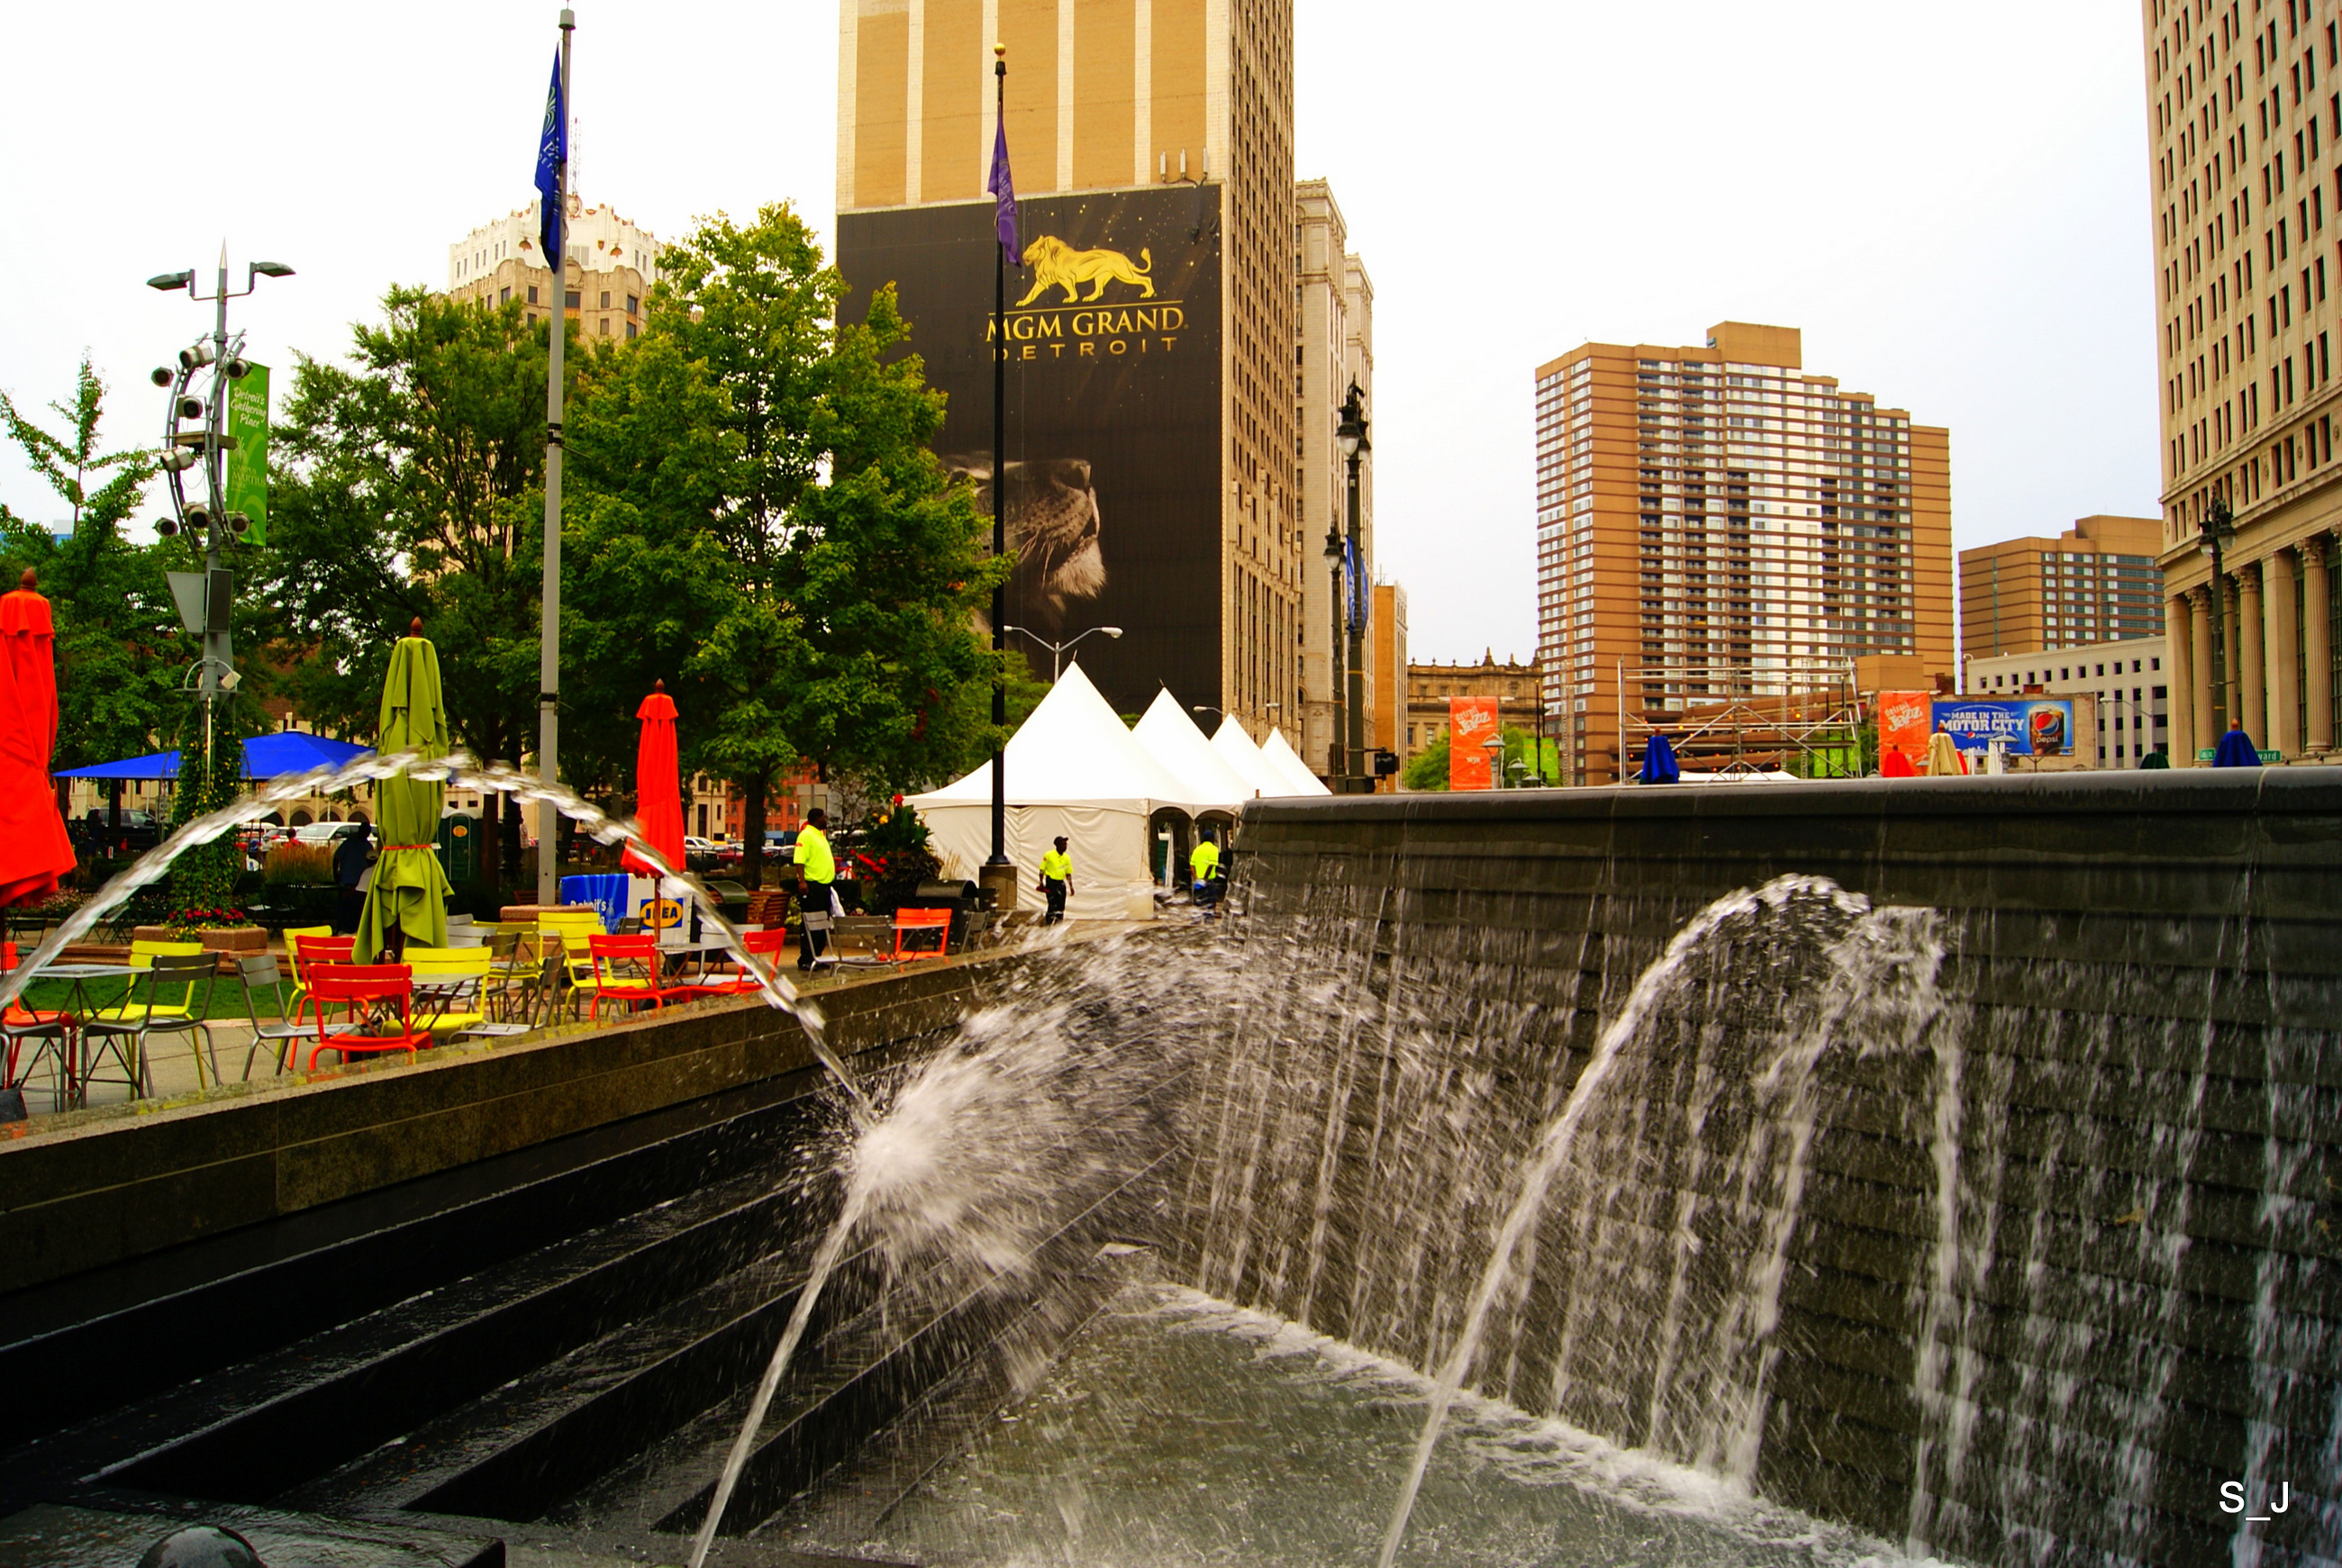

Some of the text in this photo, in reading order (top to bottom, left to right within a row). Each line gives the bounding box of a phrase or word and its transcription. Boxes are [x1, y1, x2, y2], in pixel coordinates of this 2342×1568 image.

[985, 307, 1185, 342] MGM GRAND
[993, 337, 1177, 361] DETROIT
[233, 386, 265, 405] Detroit's
[231, 399, 267, 422] Gathering
[240, 412, 260, 428] Place
[1951, 711, 2011, 720] MADE IN THE
[1939, 719, 2024, 731] MOTOR CITY
[2036, 736, 2059, 744] pepsi
[646, 907, 678, 920] IEA
